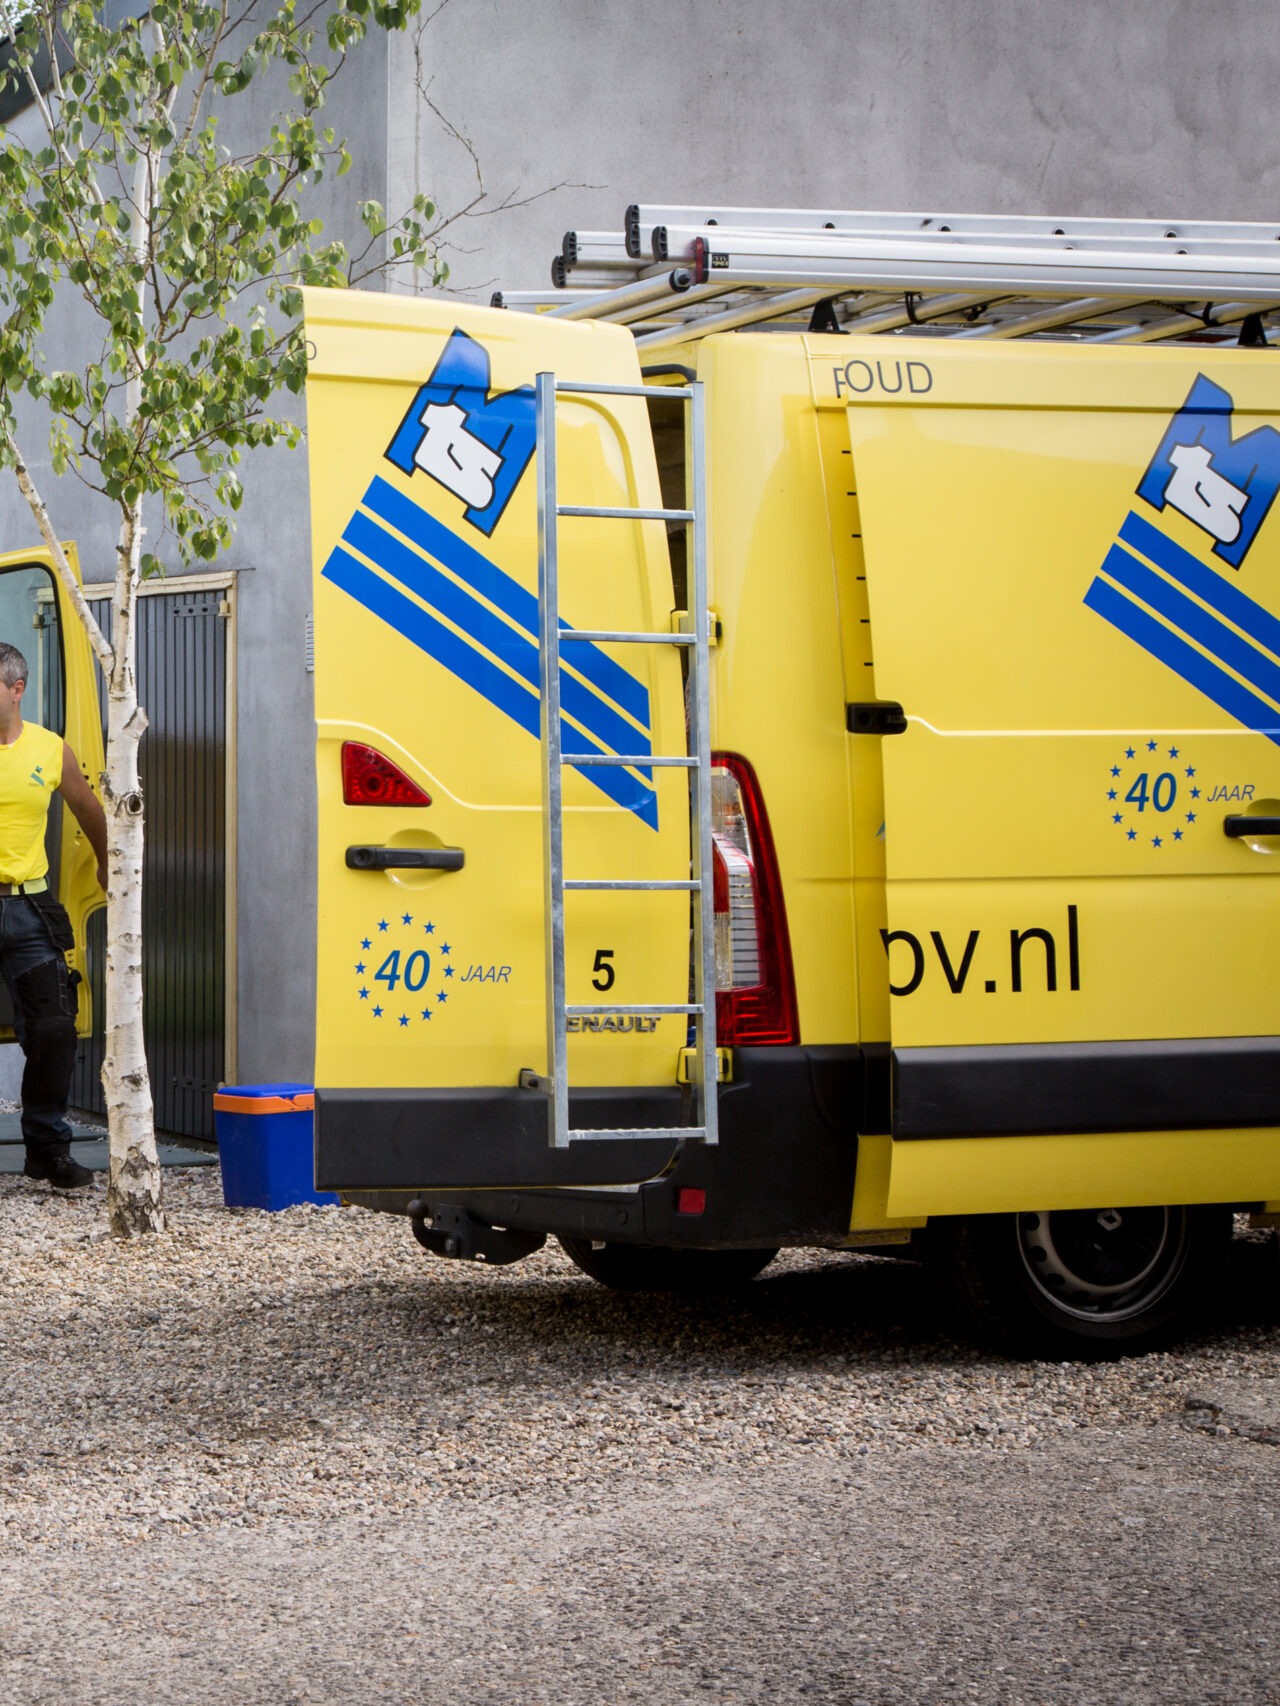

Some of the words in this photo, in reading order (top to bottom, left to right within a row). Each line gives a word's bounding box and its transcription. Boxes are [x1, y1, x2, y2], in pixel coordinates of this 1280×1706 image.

[1124, 772, 1177, 813] 40
[1207, 785, 1255, 802] JAAR
[374, 949, 431, 992] 40
[460, 965, 512, 983] JAAR
[591, 949, 616, 992] 5
[565, 1015, 662, 1033] ENAULT
